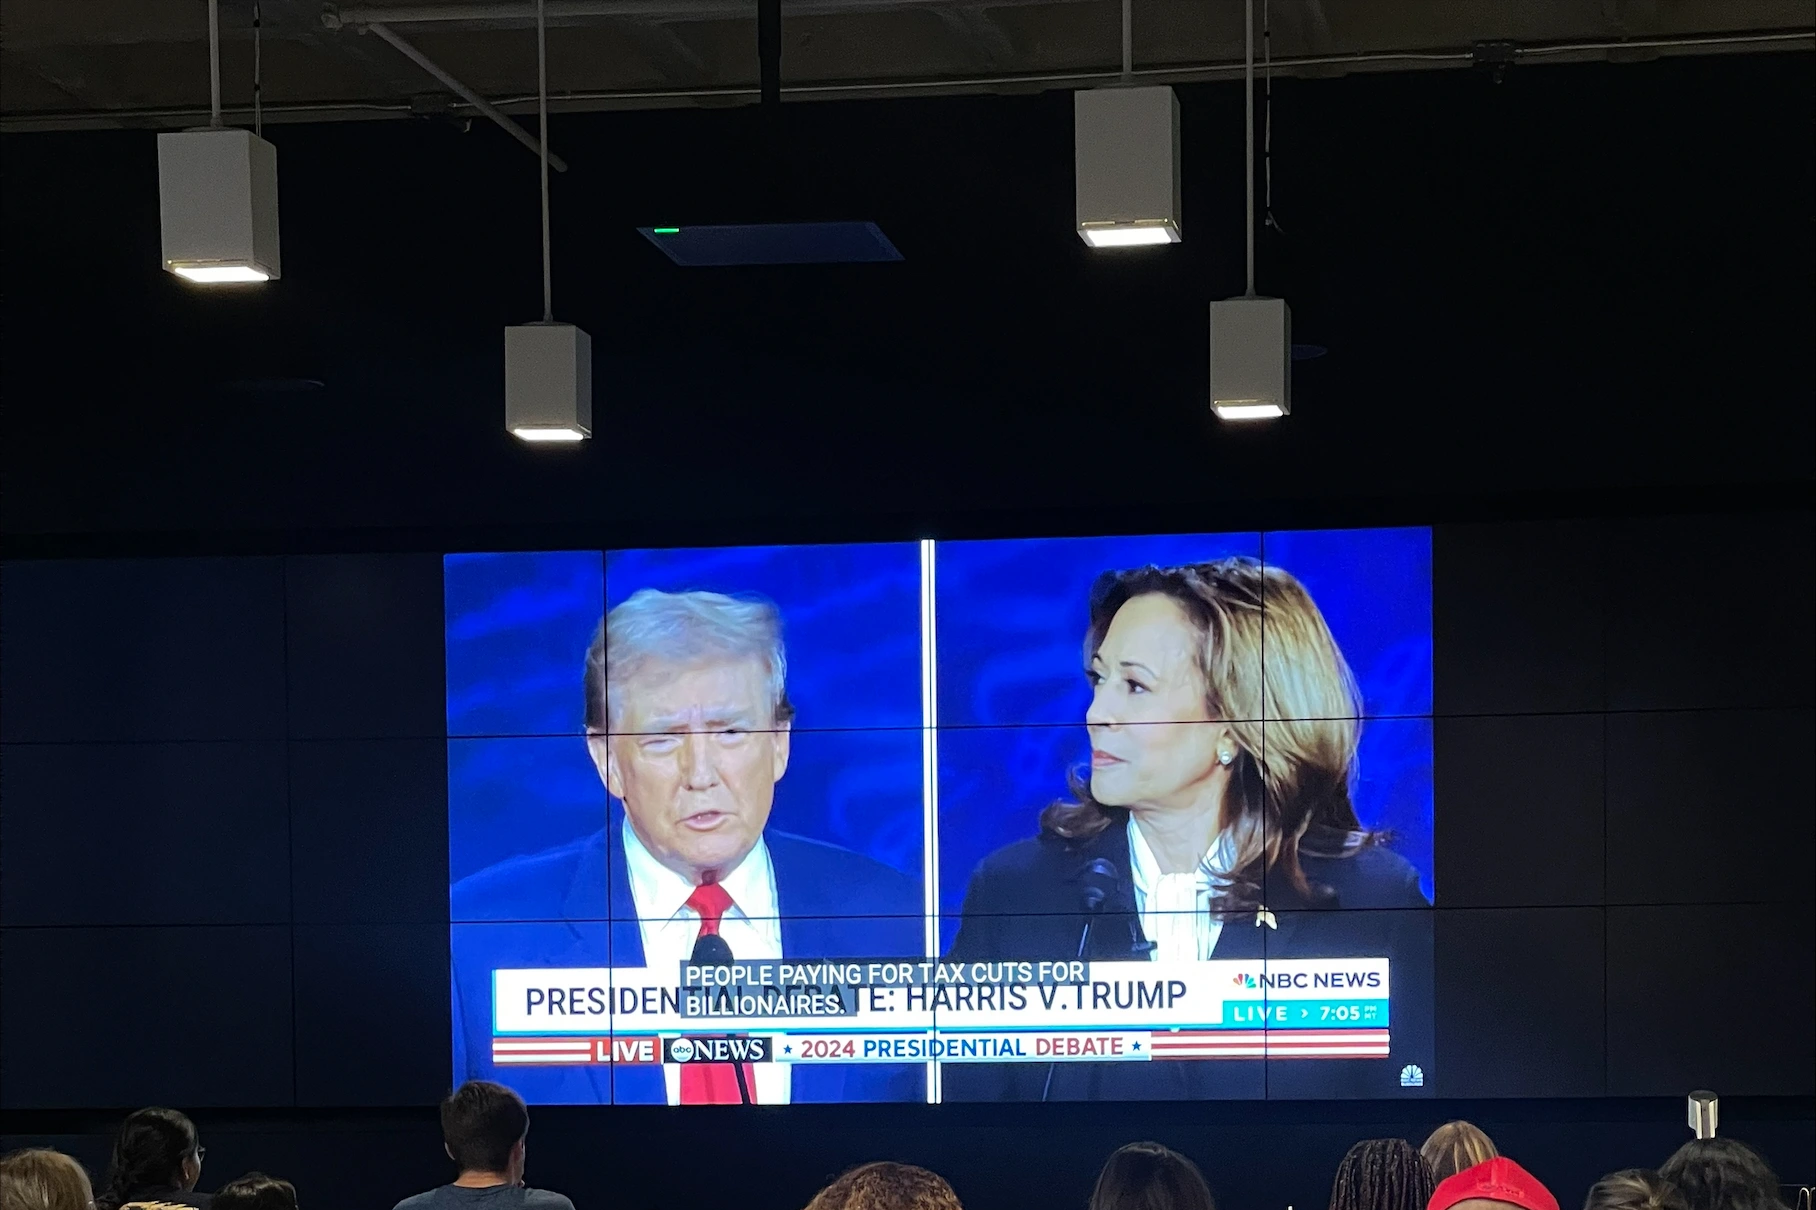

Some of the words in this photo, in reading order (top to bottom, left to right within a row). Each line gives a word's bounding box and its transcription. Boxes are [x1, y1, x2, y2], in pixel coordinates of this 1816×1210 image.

[686, 964, 774, 987] PEOPLE
[779, 963, 862, 986] PAYING
[868, 963, 914, 985] FOR
[918, 962, 966, 984] TAX
[971, 961, 1033, 983] CUTS
[1039, 961, 1085, 983] FOR
[1259, 973, 1308, 988] NBC
[1314, 972, 1381, 988] NEWS
[686, 994, 846, 1017] BILLIONAIRES.
[906, 982, 1028, 1012] HARRIS
[1233, 1005, 1288, 1022] LIVE
[1319, 1005, 1361, 1021] 7:05
[596, 1040, 655, 1062] LIVE
[673, 1045, 692, 1054] abc
[693, 1039, 765, 1061] NEWS
[801, 1039, 856, 1059] 2024
[863, 1038, 1027, 1058] PRESIDENTIAL
[1036, 1036, 1124, 1056] DEBATE
